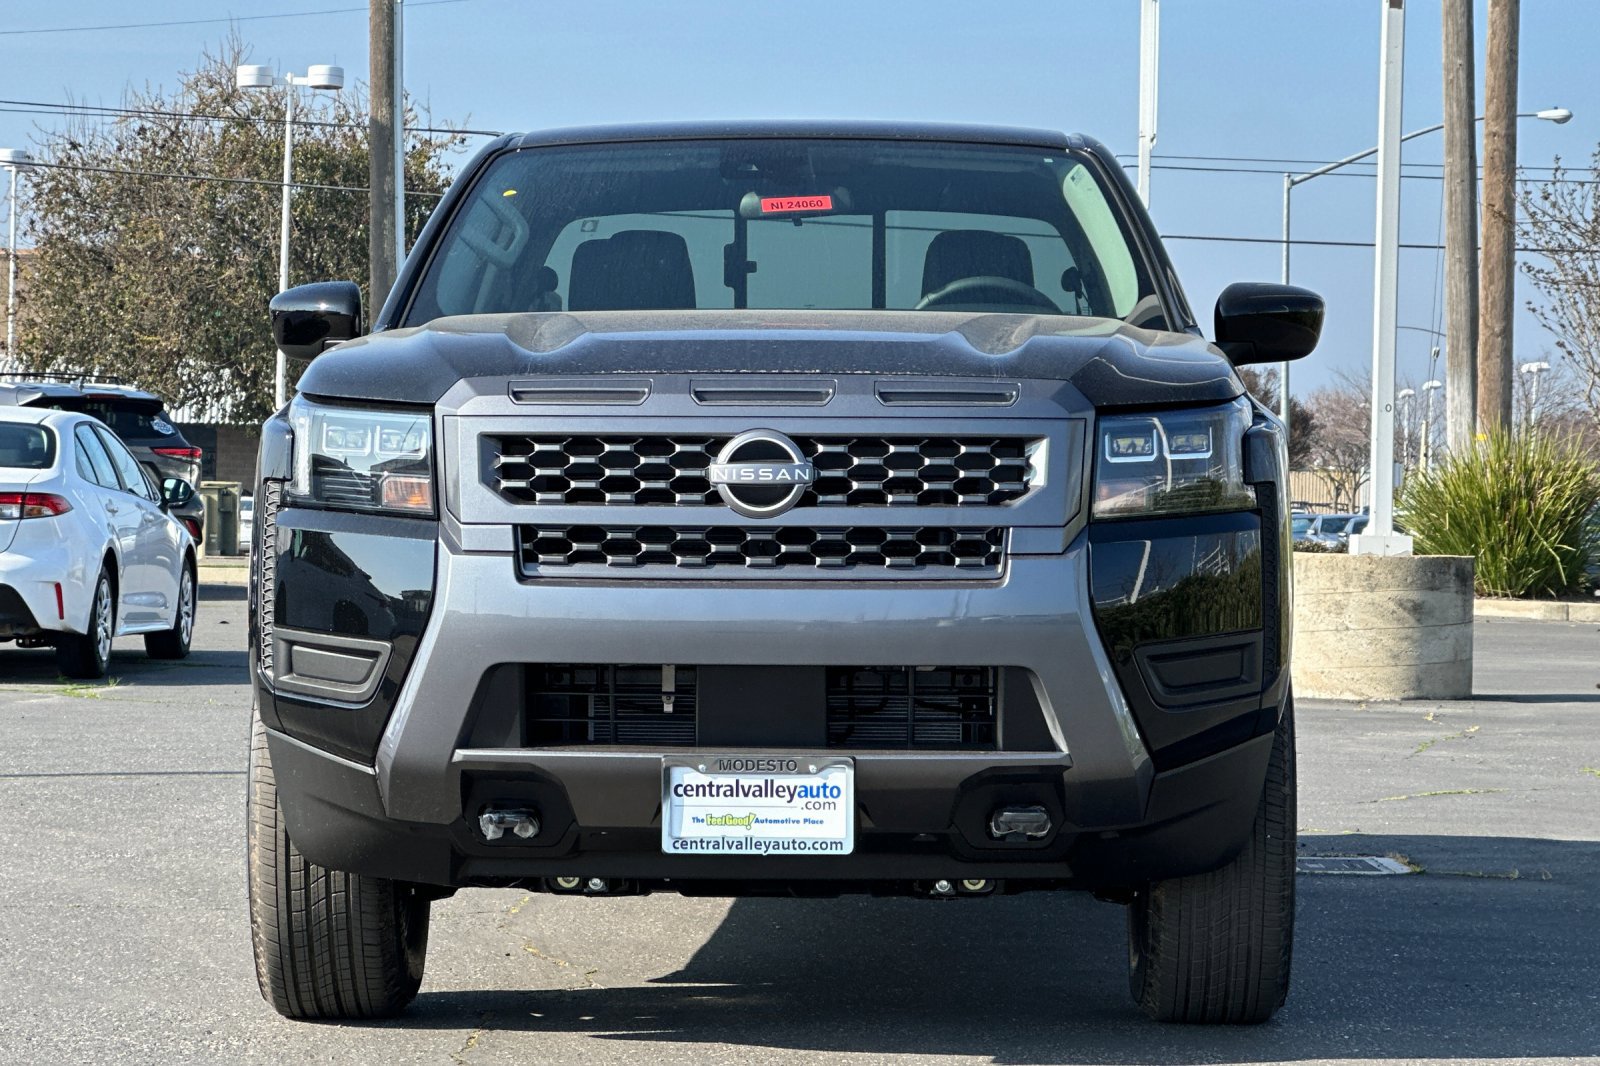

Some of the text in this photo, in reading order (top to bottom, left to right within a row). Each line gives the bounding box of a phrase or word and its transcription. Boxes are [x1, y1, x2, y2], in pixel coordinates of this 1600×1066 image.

[787, 200, 823, 208] 24060
[714, 468, 809, 480] NISSAN
[718, 759, 797, 771] MODESTO
[673, 779, 841, 803] centralvalleyauto
[801, 801, 836, 810] .com
[672, 837, 844, 854] centralvalleyauto.com
